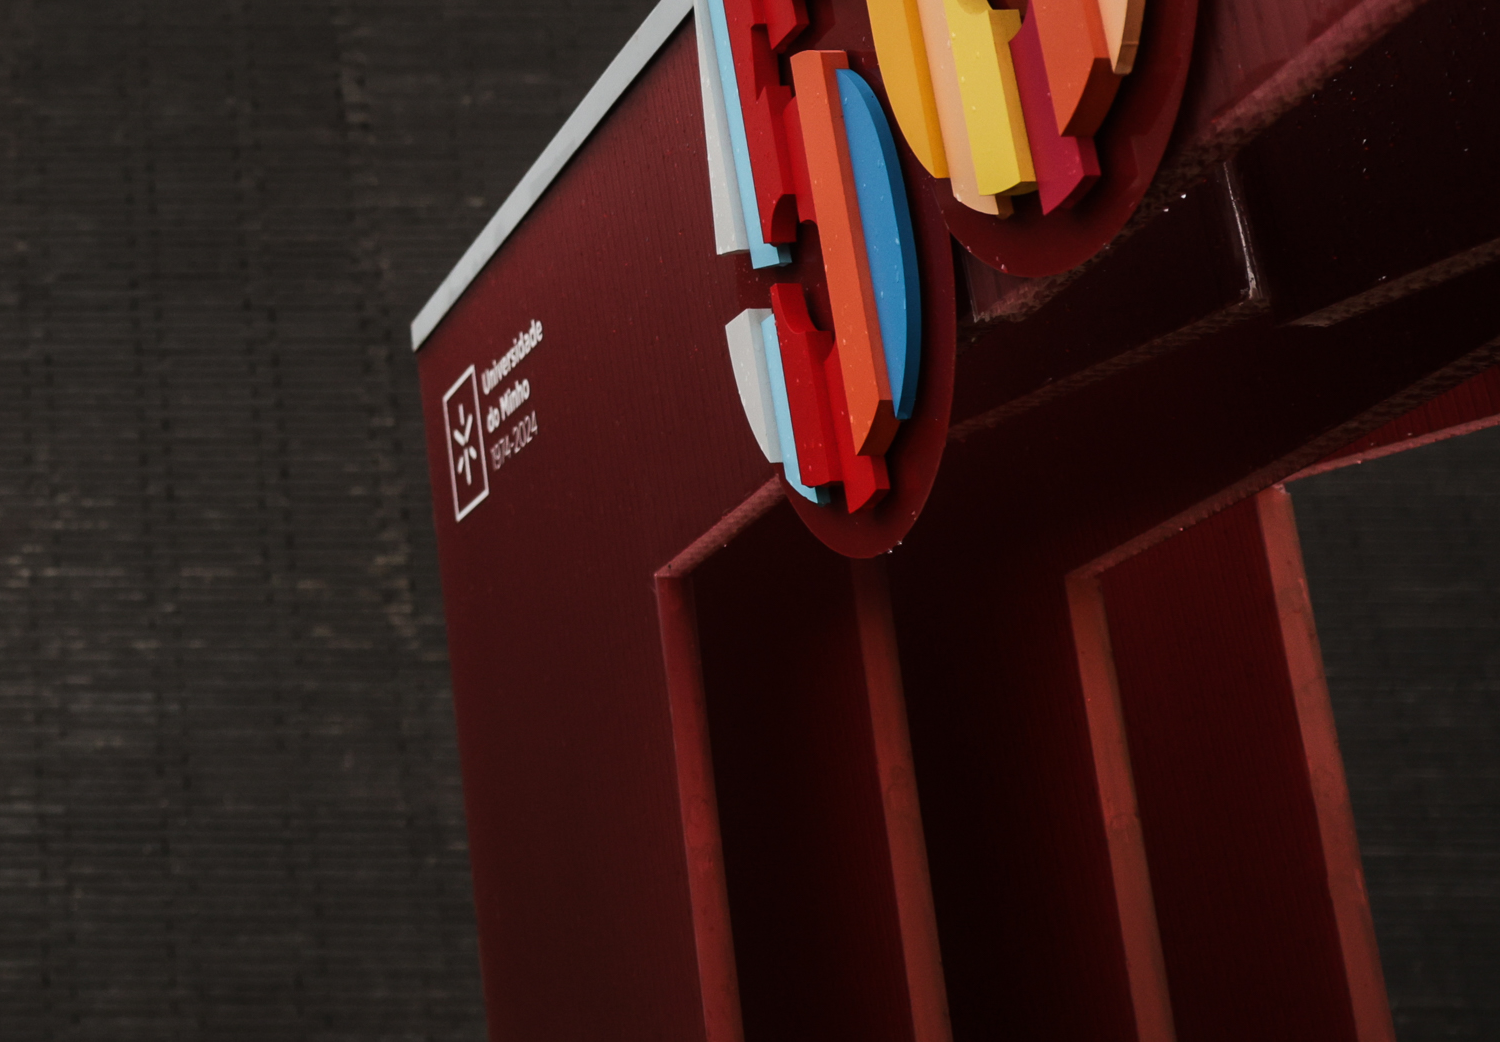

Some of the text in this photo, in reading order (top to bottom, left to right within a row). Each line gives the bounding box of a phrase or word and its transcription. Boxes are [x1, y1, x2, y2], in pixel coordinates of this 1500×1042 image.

[481, 319, 543, 395] Universidade
[487, 379, 530, 433] do Minho
[491, 410, 538, 471] 1974-2024
